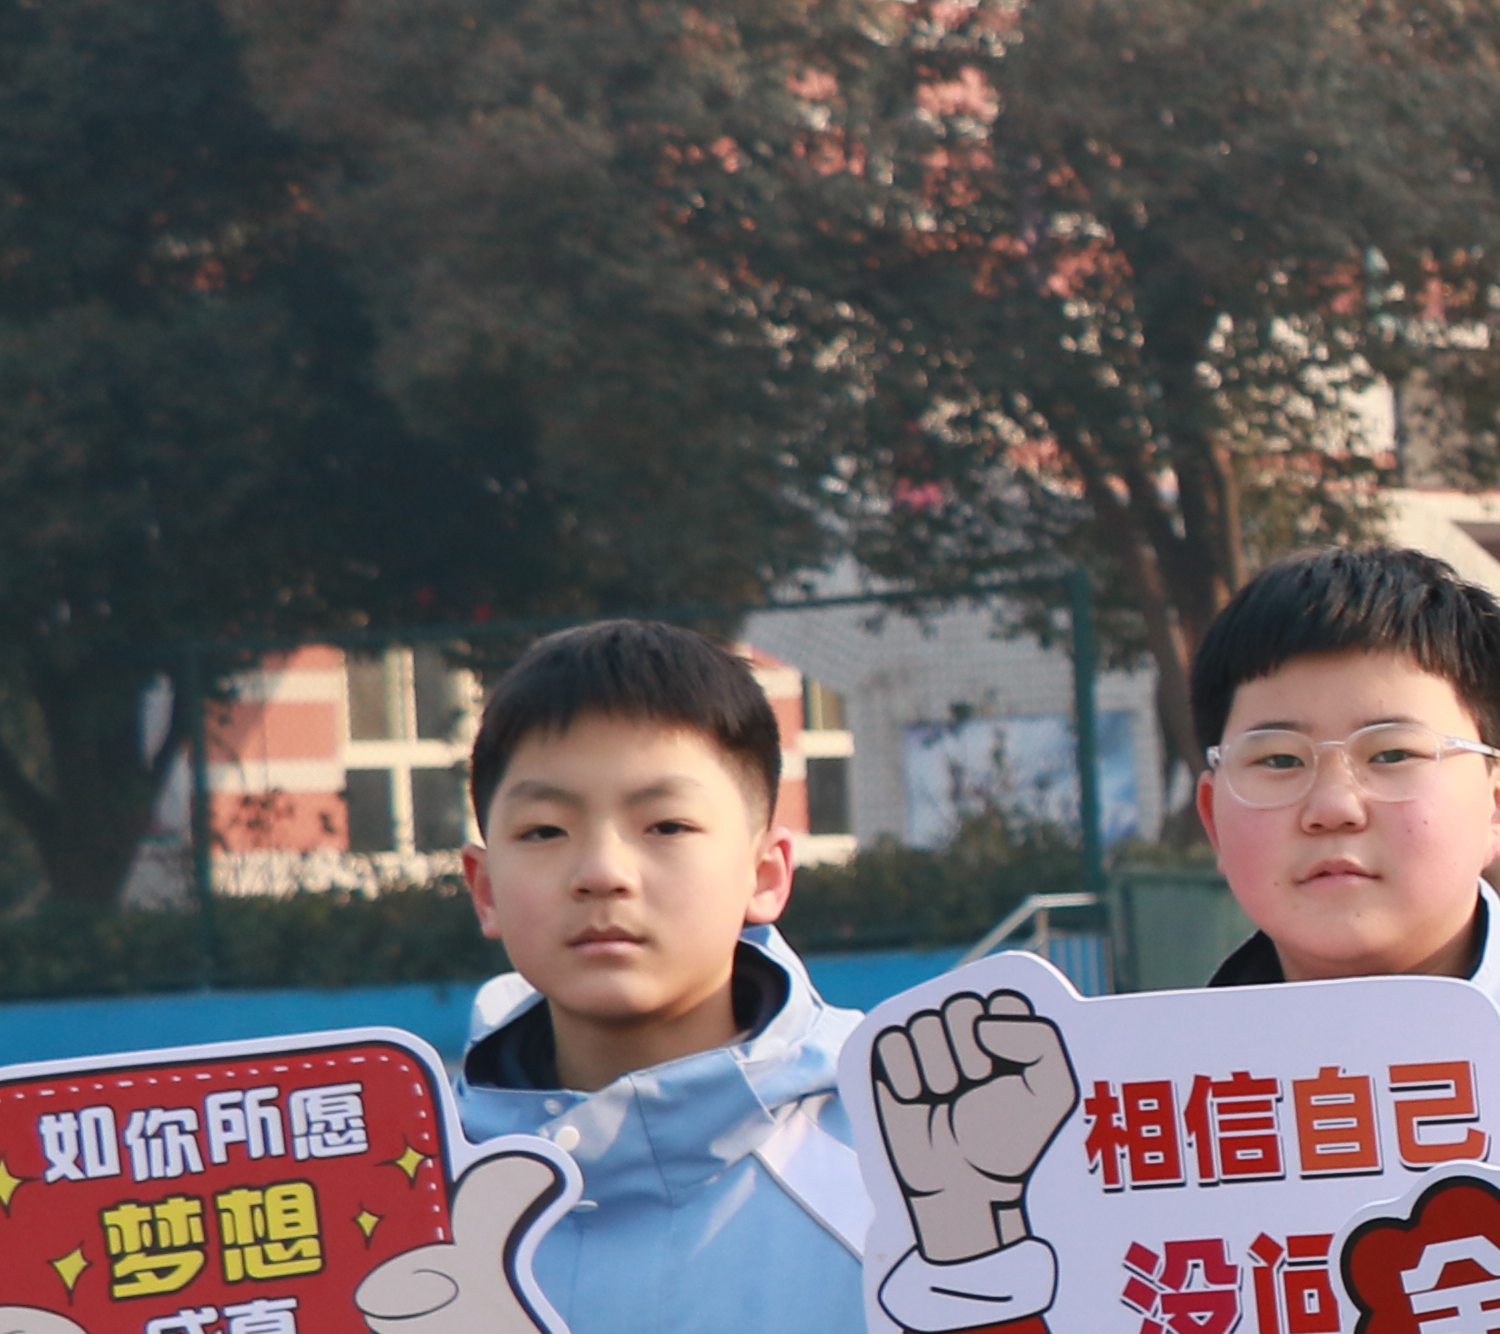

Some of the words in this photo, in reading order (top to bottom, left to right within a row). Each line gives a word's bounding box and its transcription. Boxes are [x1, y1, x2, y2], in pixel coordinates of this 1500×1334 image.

[38, 1082, 369, 1184] 如你所愿
[1083, 1059, 1492, 1193] 相信自己
[101, 1179, 324, 1301] 梦想
